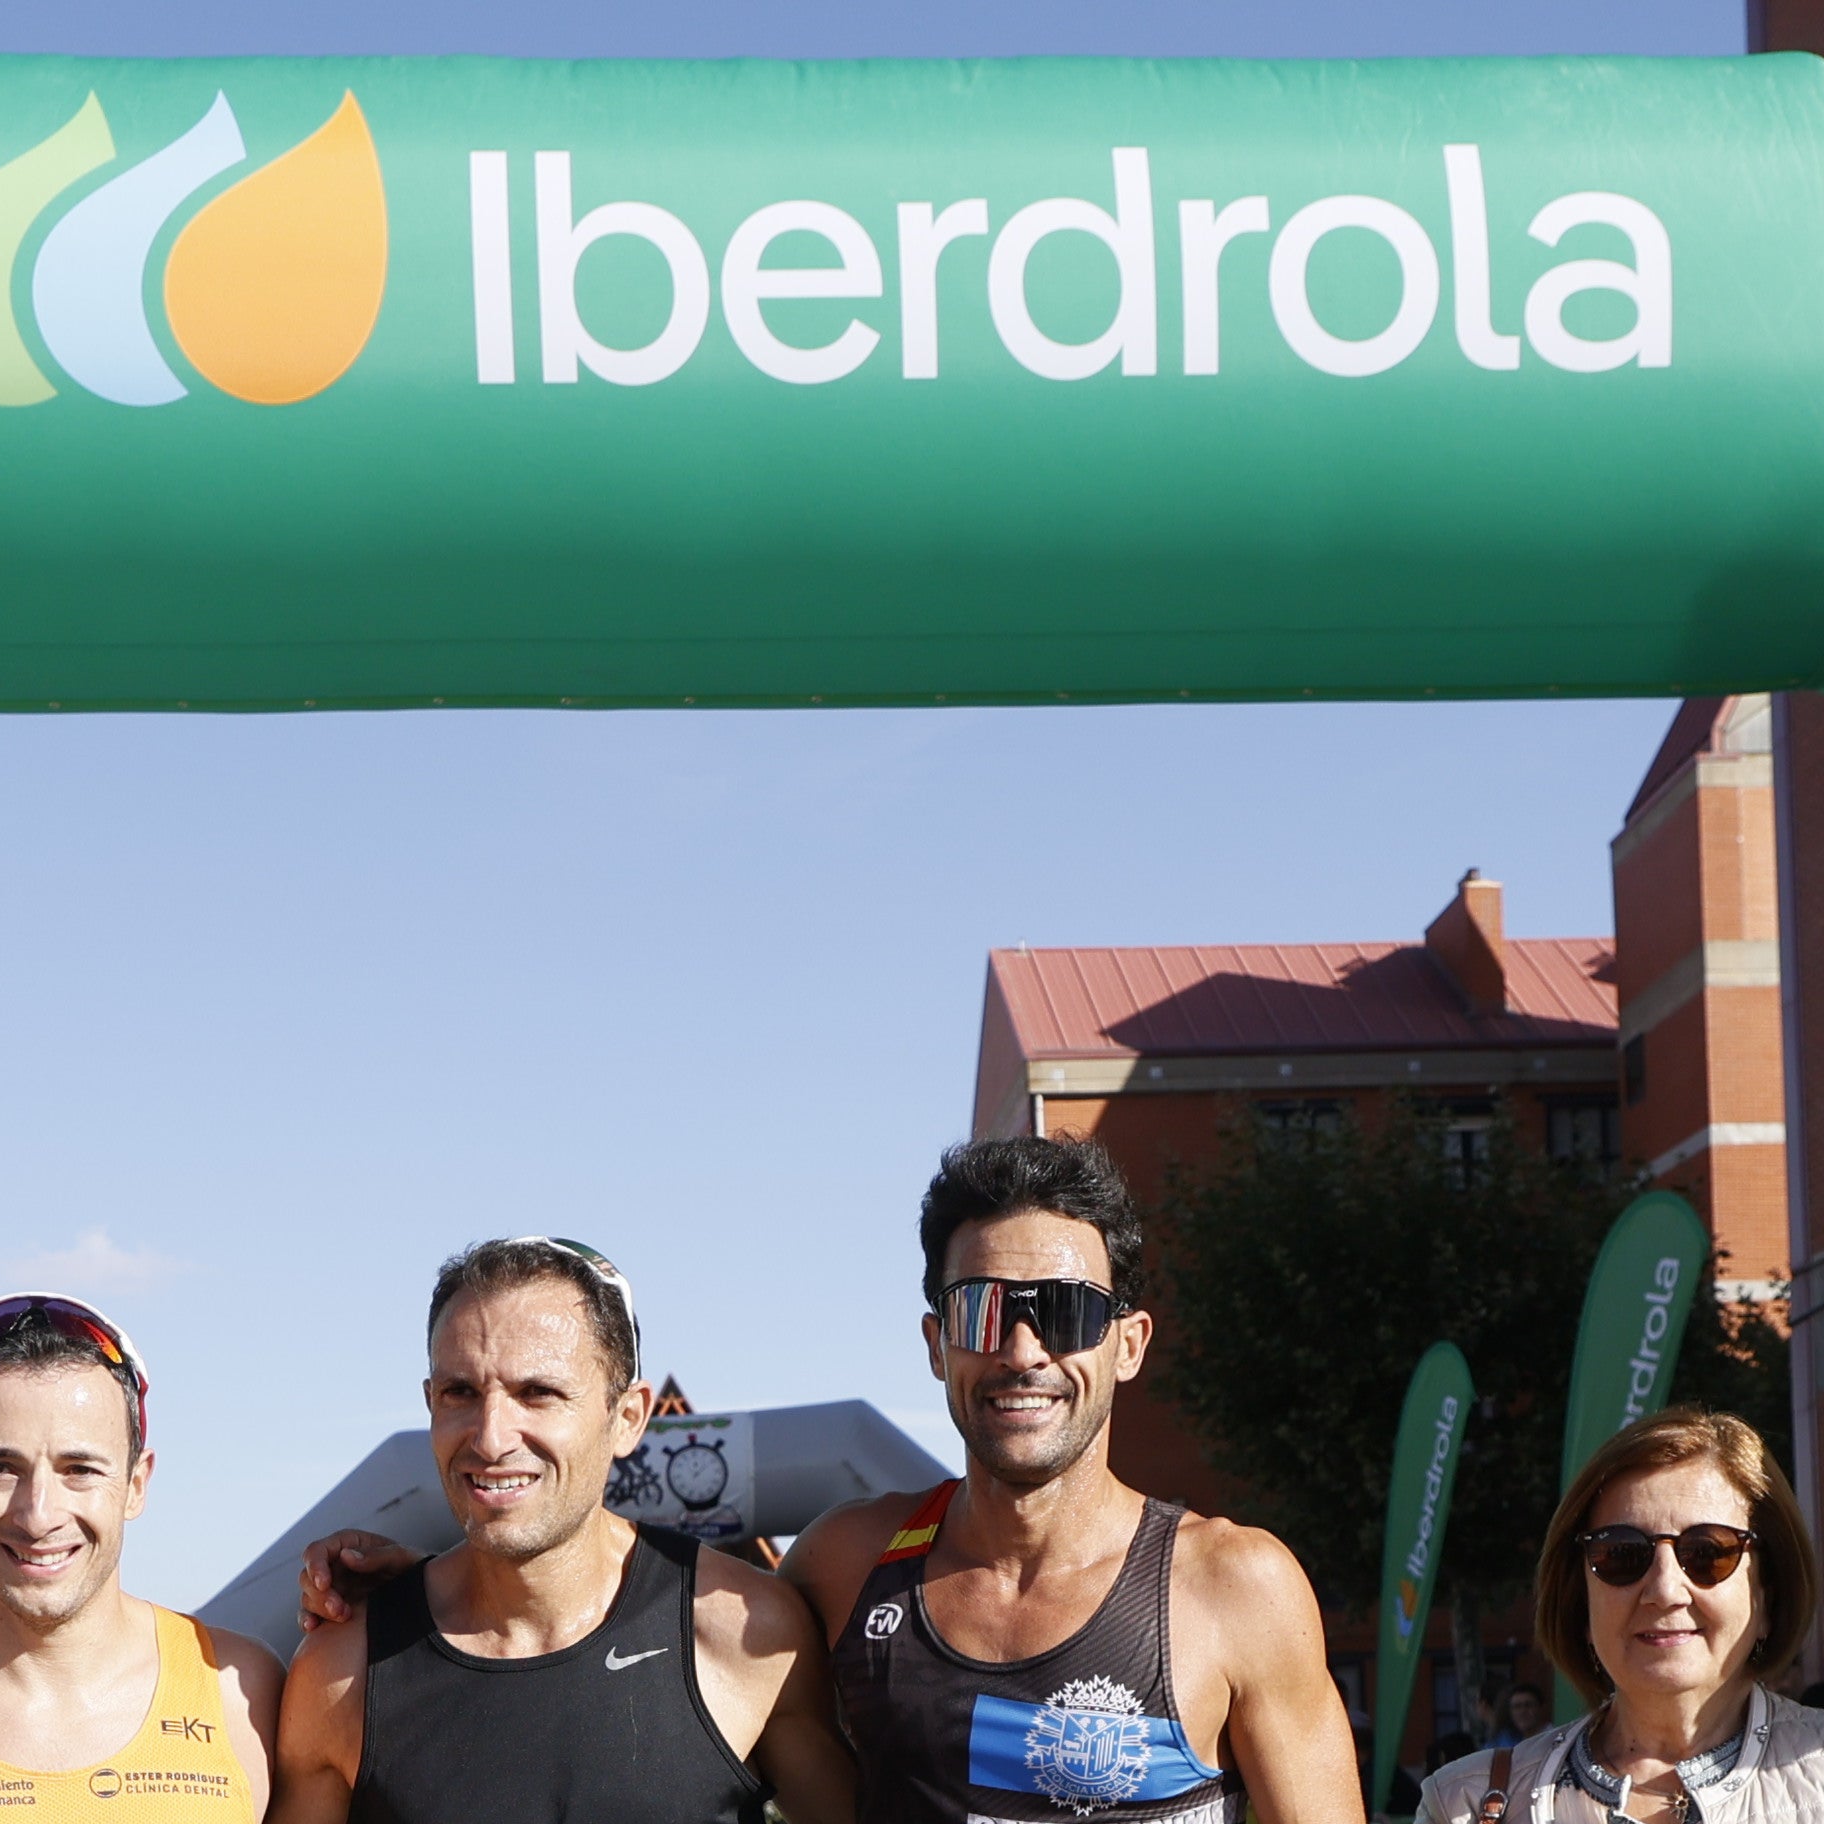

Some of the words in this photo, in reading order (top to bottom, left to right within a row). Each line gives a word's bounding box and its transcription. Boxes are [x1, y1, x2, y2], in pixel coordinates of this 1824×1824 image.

[469, 143, 1672, 386] Iberdrola
[1619, 1257, 1680, 1430] rdrola
[1405, 1395, 1458, 1579] Iberdrola
[161, 1716, 216, 1744] EKT
[125, 1772, 163, 1782] ESTER
[125, 1782, 180, 1795] CLÍNICA
[184, 1784, 231, 1799] DENTAL
[1090, 1775, 1128, 1795] LOCAL
